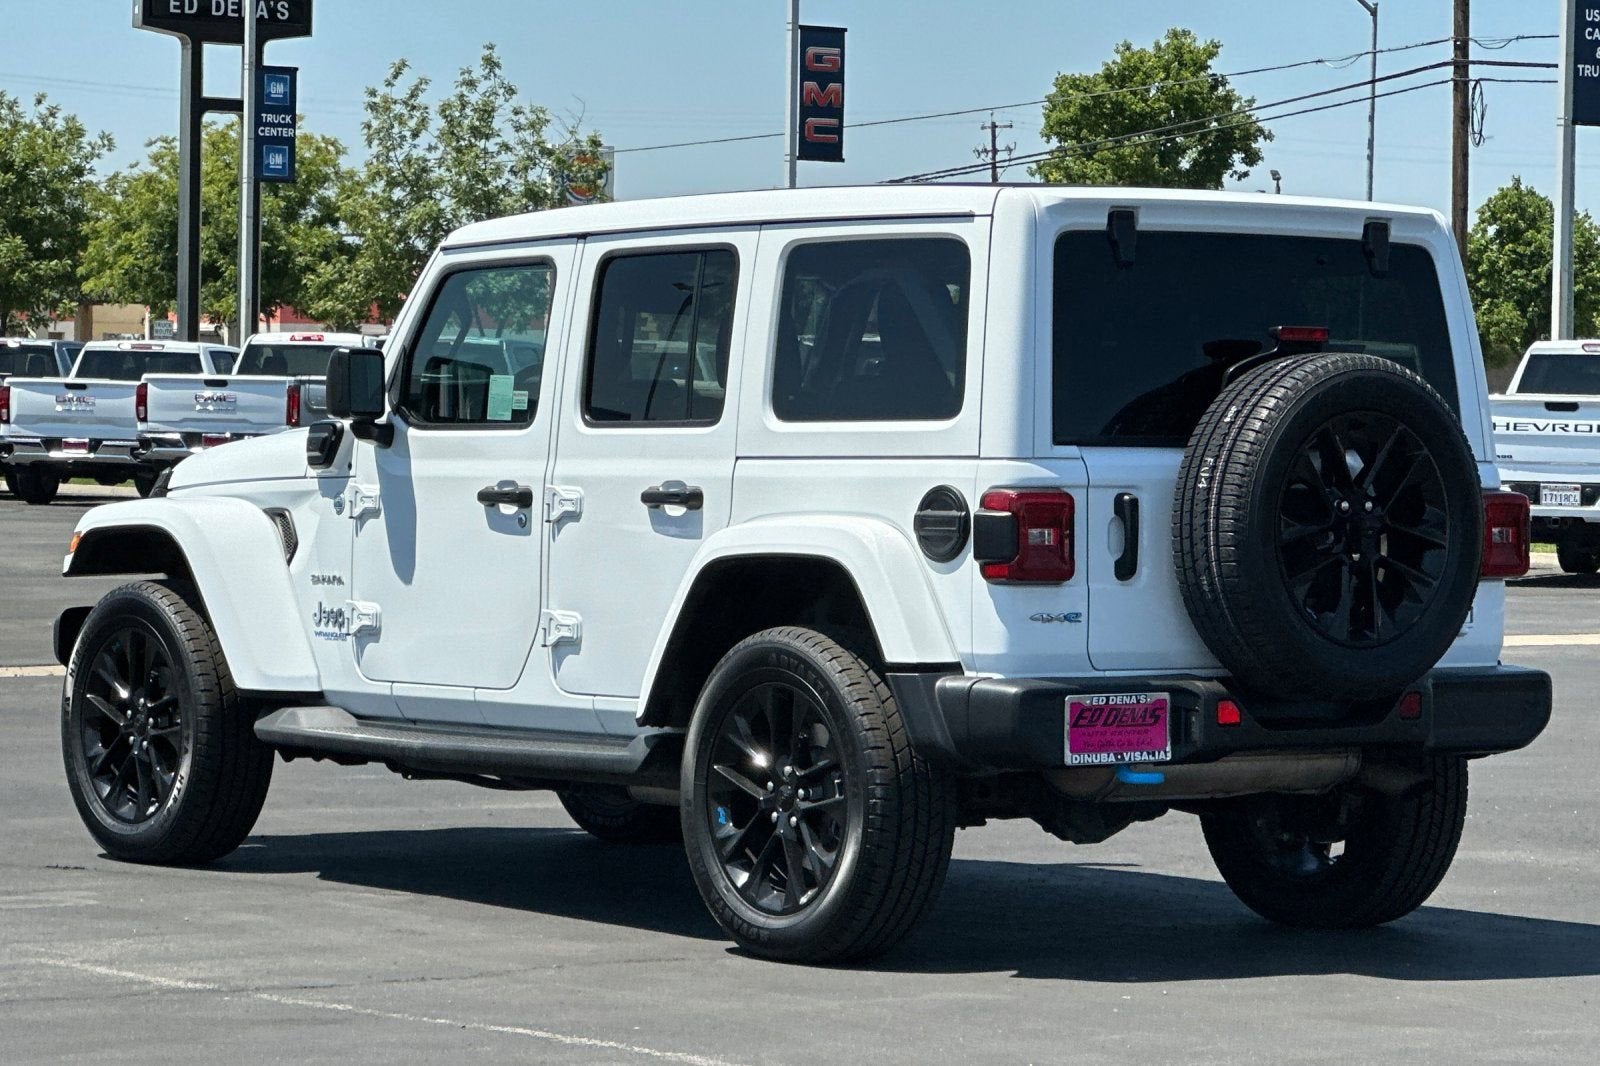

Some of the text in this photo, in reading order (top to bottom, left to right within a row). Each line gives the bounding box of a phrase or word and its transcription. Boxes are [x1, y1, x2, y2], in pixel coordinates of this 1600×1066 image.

[169, 0, 289, 20] ED DEA'S
[270, 82, 284, 93] GM
[803, 46, 842, 142] GMC
[261, 113, 292, 124] TRUCK
[258, 126, 294, 138] CENTER
[269, 153, 283, 164] GM
[1493, 421, 1600, 433] HEVRO
[313, 601, 345, 631] Jeep
[1092, 695, 1148, 705] ED DENA'S
[1072, 750, 1166, 764] DINUBA VISALIA
